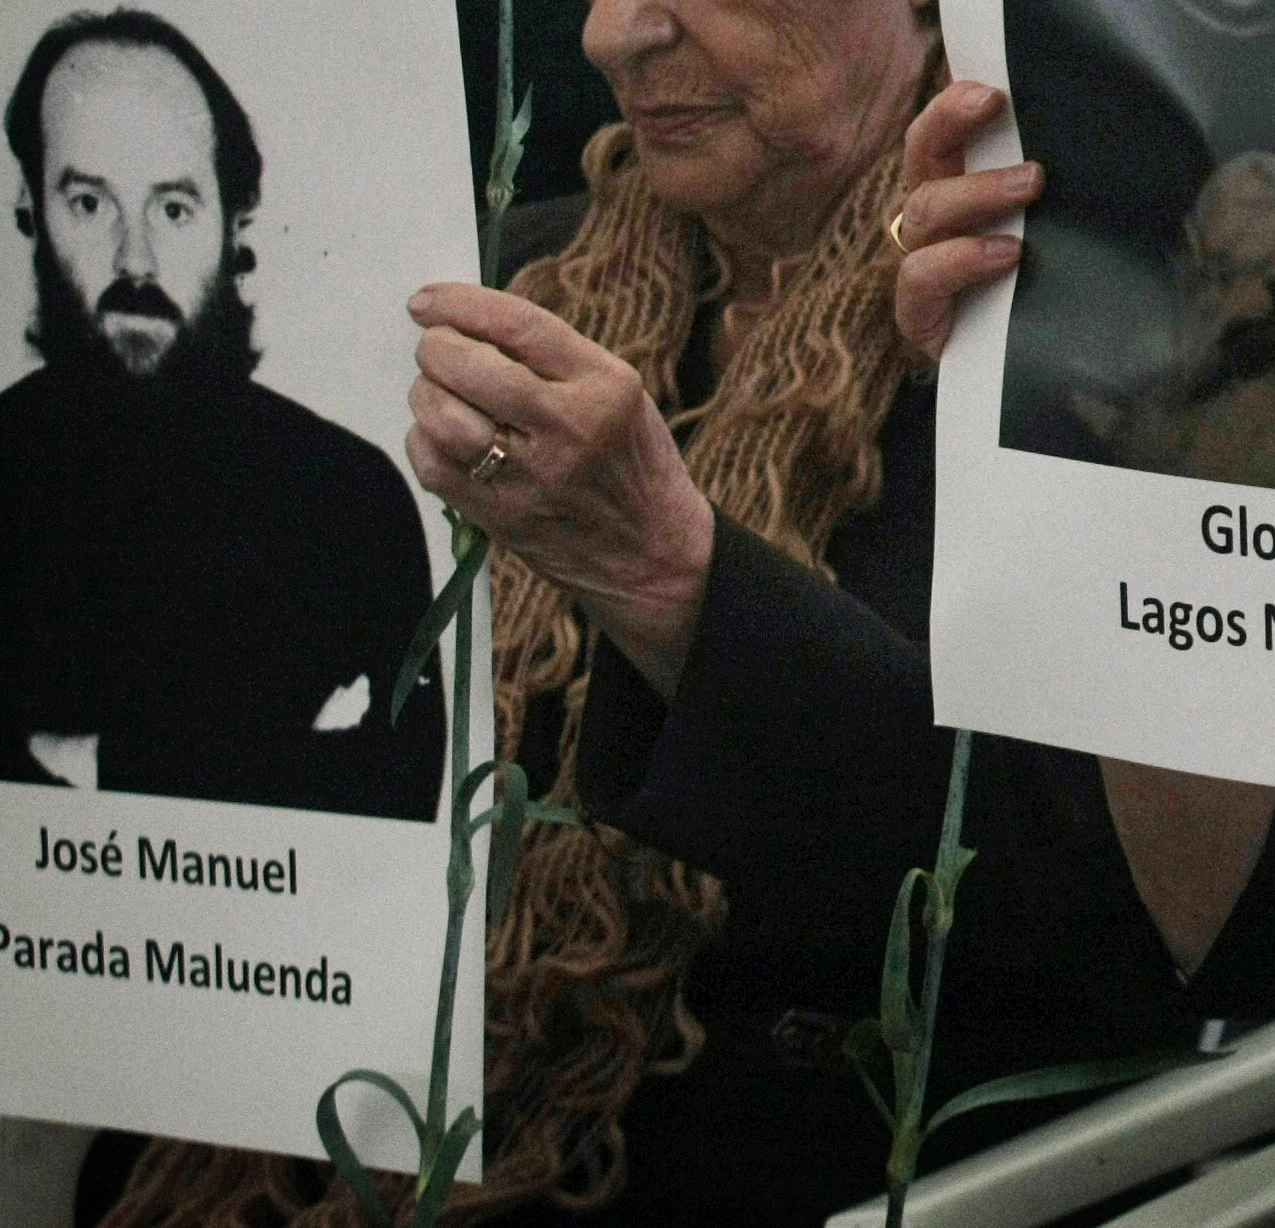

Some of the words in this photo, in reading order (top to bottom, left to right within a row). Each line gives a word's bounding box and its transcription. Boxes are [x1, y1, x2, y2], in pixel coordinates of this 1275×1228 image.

[1119, 581, 1247, 651] Lagos
[35, 826, 123, 877] José
[137, 836, 297, 895] Manuel
[145, 938, 352, 1006] Maluenda
